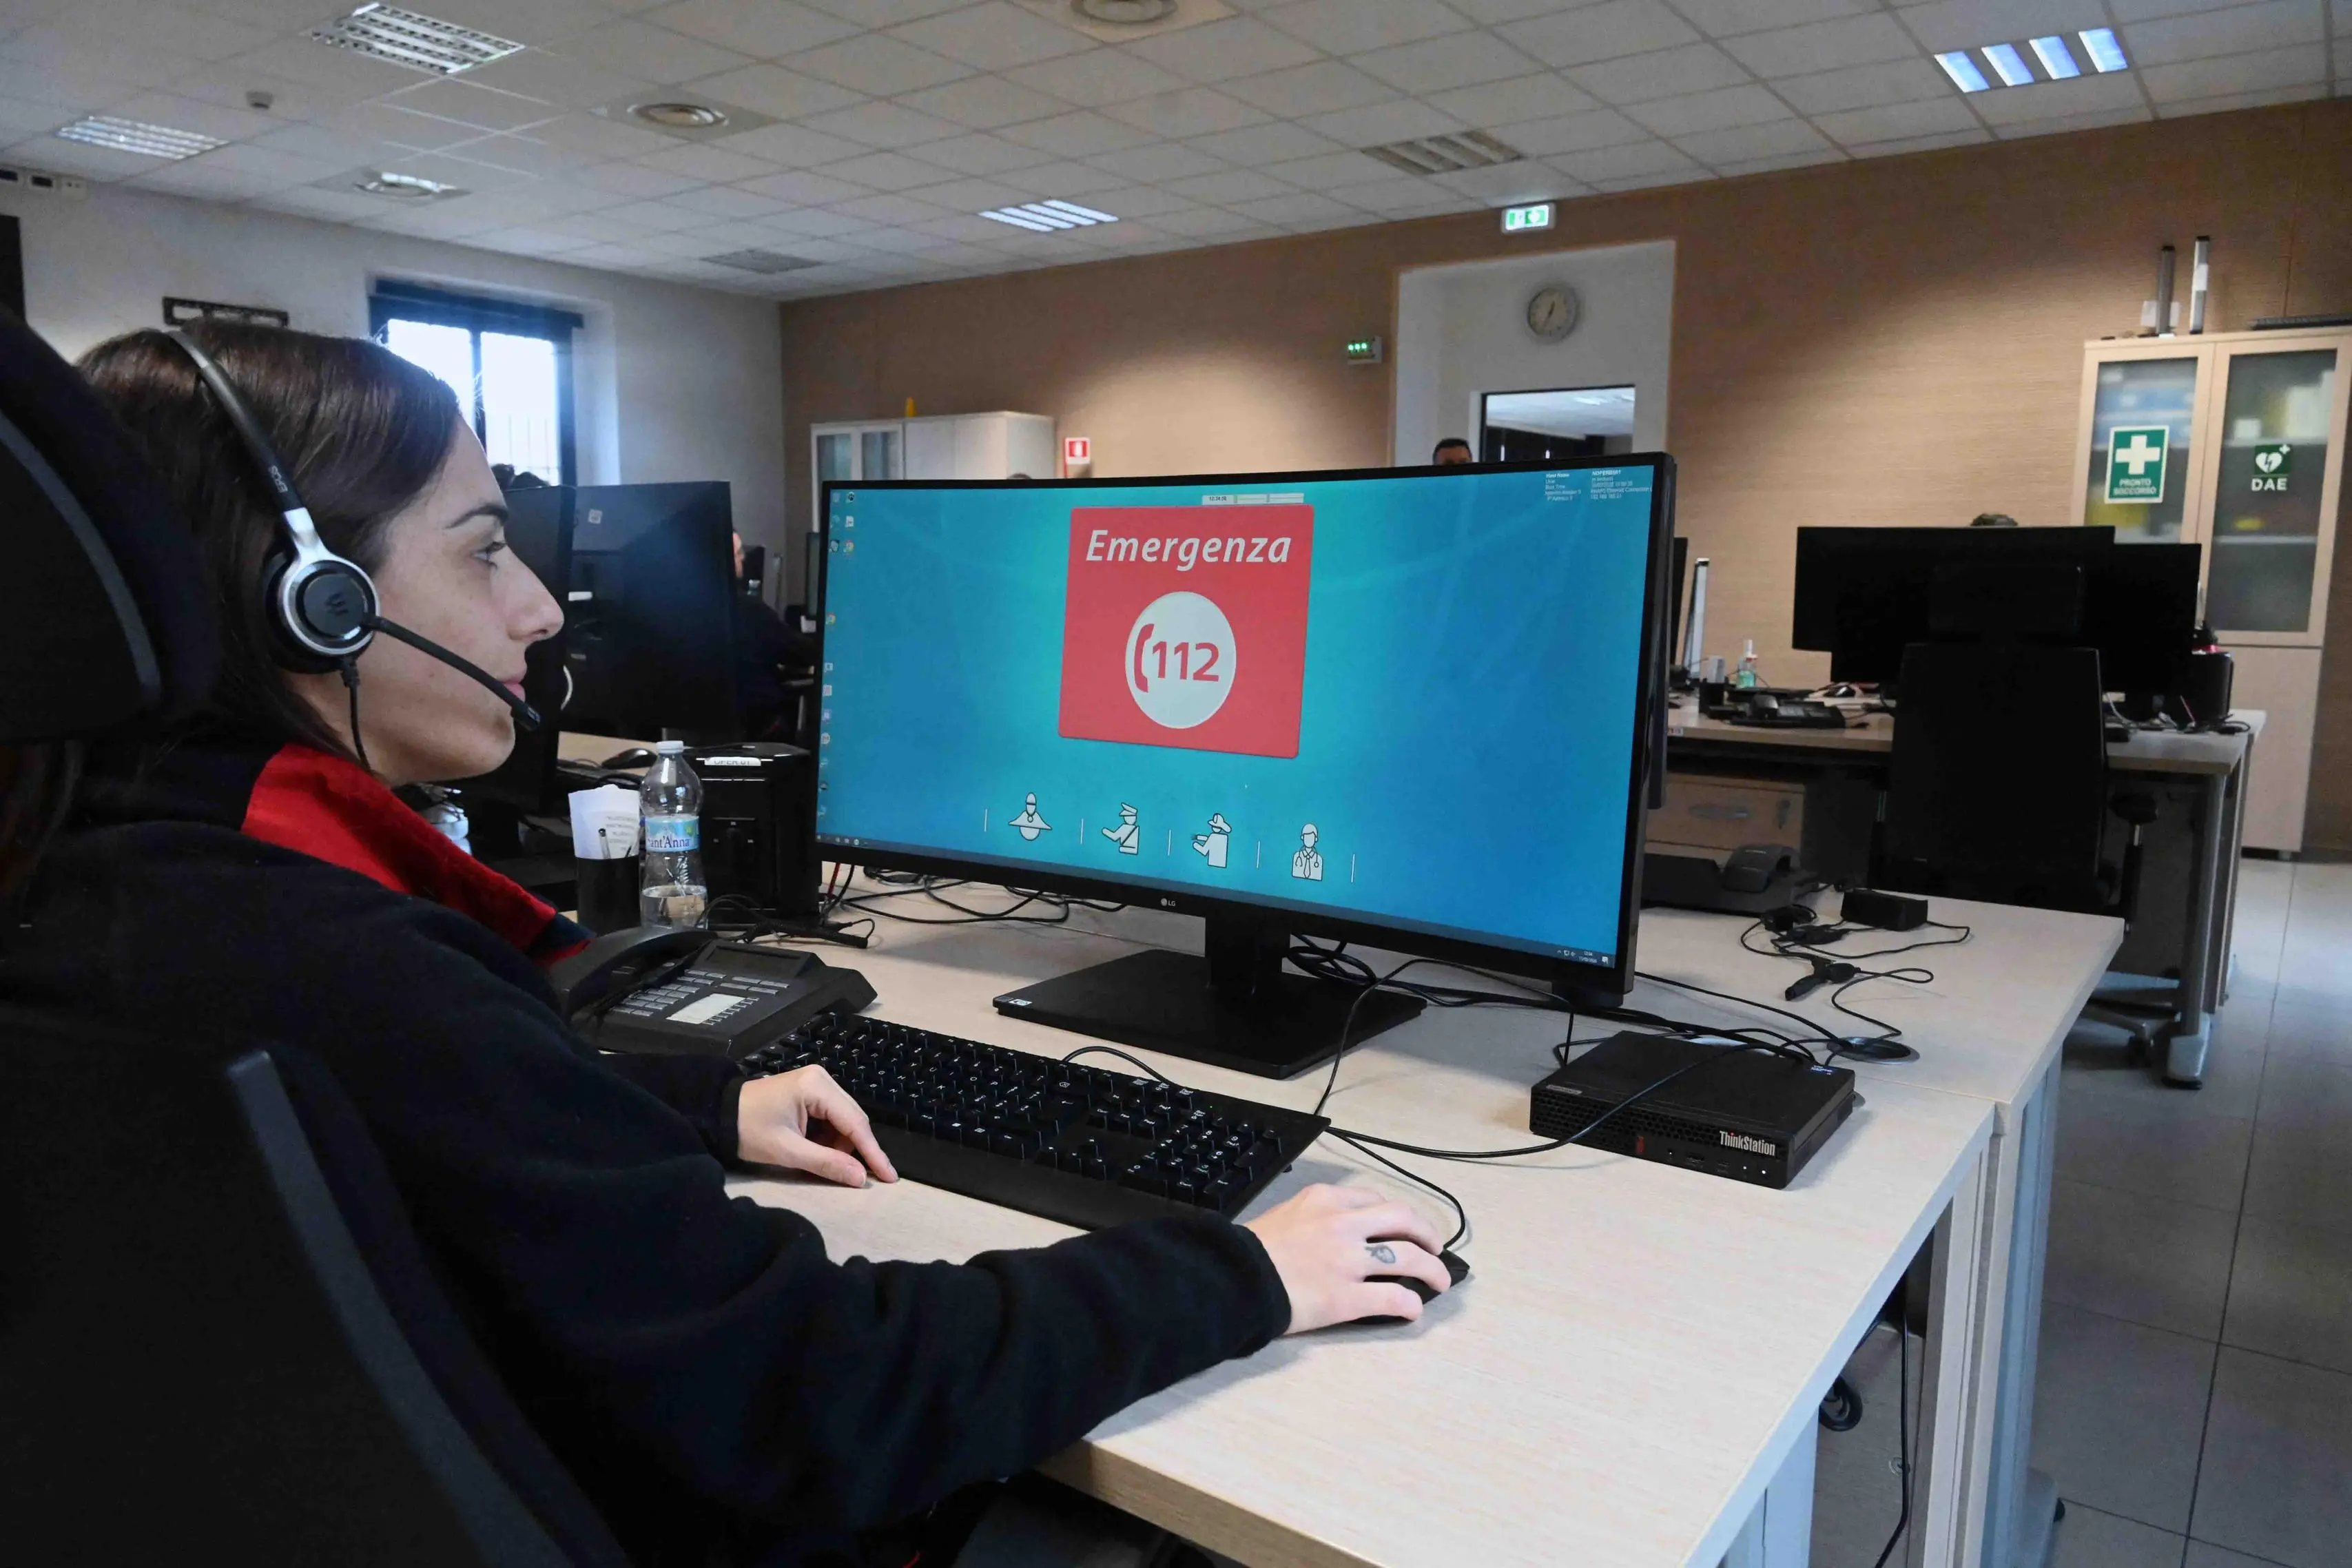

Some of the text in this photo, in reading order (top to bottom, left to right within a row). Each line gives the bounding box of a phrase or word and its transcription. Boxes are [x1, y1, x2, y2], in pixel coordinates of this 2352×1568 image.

[2118, 478, 2152, 486] PRONTO
[2251, 478, 2287, 491] DAE
[1086, 530, 1292, 571] Emergenza
[1152, 641, 1220, 681] 112
[1719, 1131, 1775, 1156] ThinkStation
